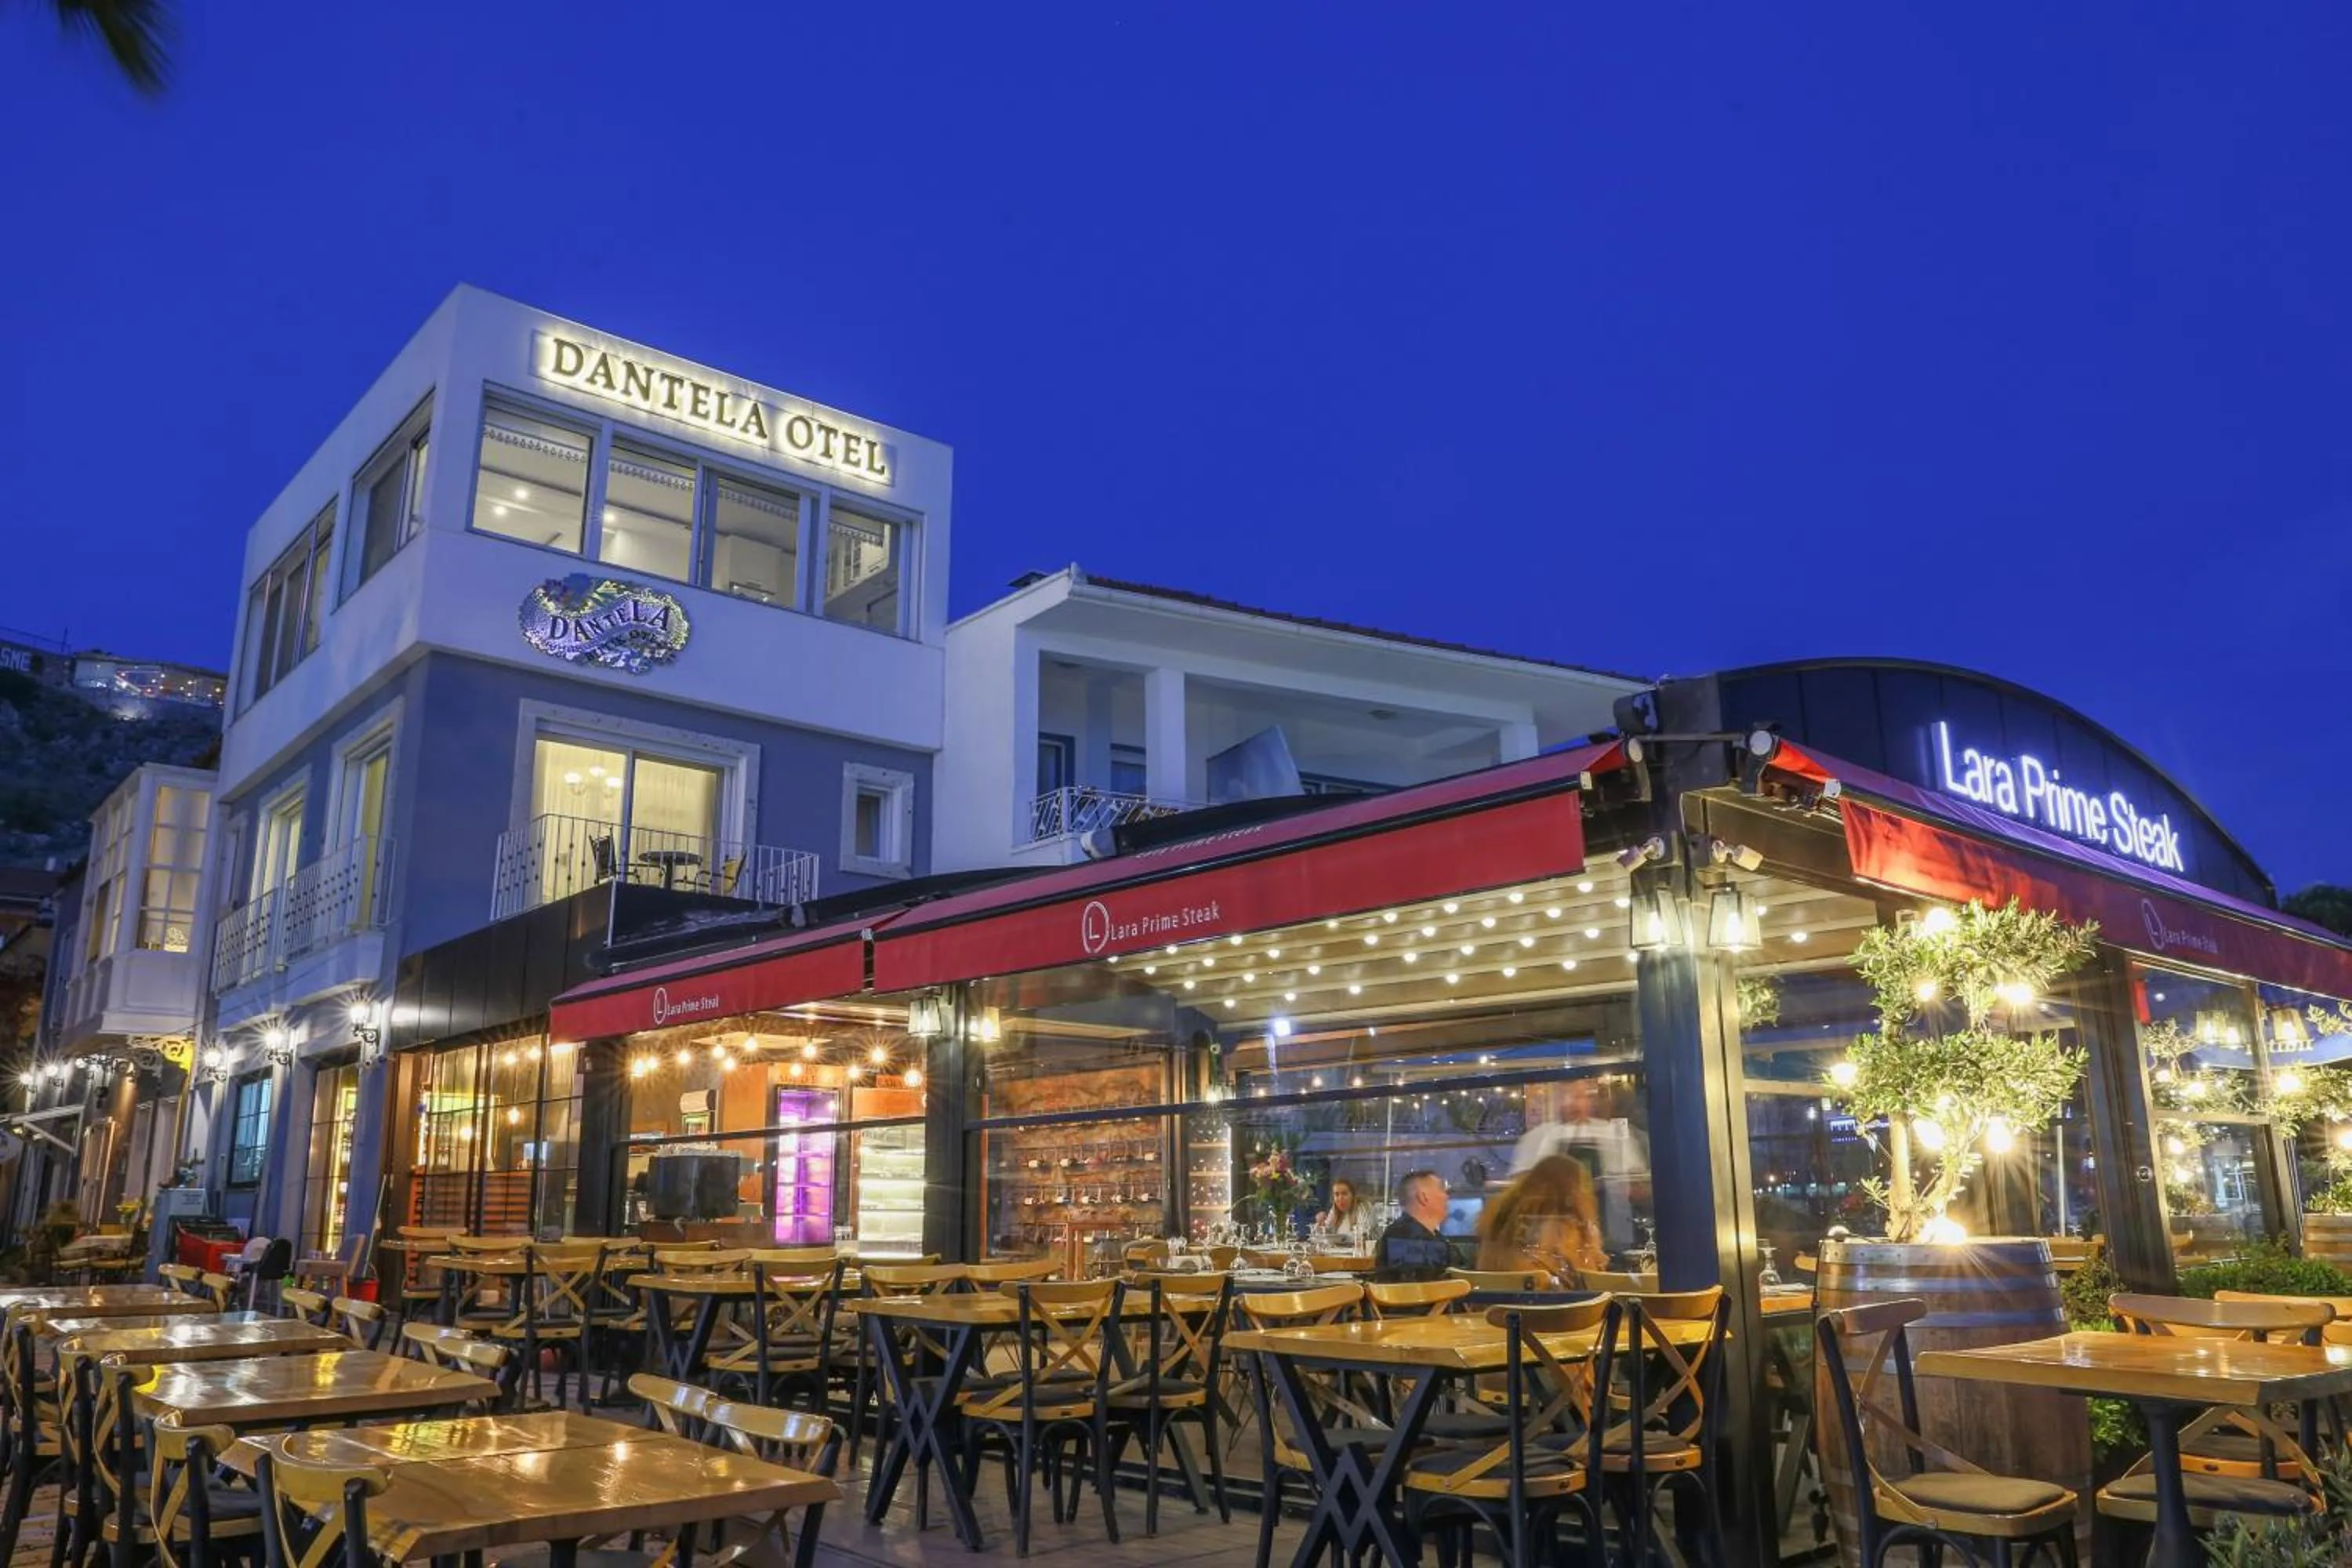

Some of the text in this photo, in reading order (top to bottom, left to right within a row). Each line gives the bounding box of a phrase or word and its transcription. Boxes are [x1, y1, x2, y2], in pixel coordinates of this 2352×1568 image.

[552, 337, 886, 475] DANTELA OTEL
[549, 600, 670, 642] DANTELA
[1938, 720, 2184, 873] Lara Prime Steak
[1111, 899, 1221, 941] Lara Prime Steak
